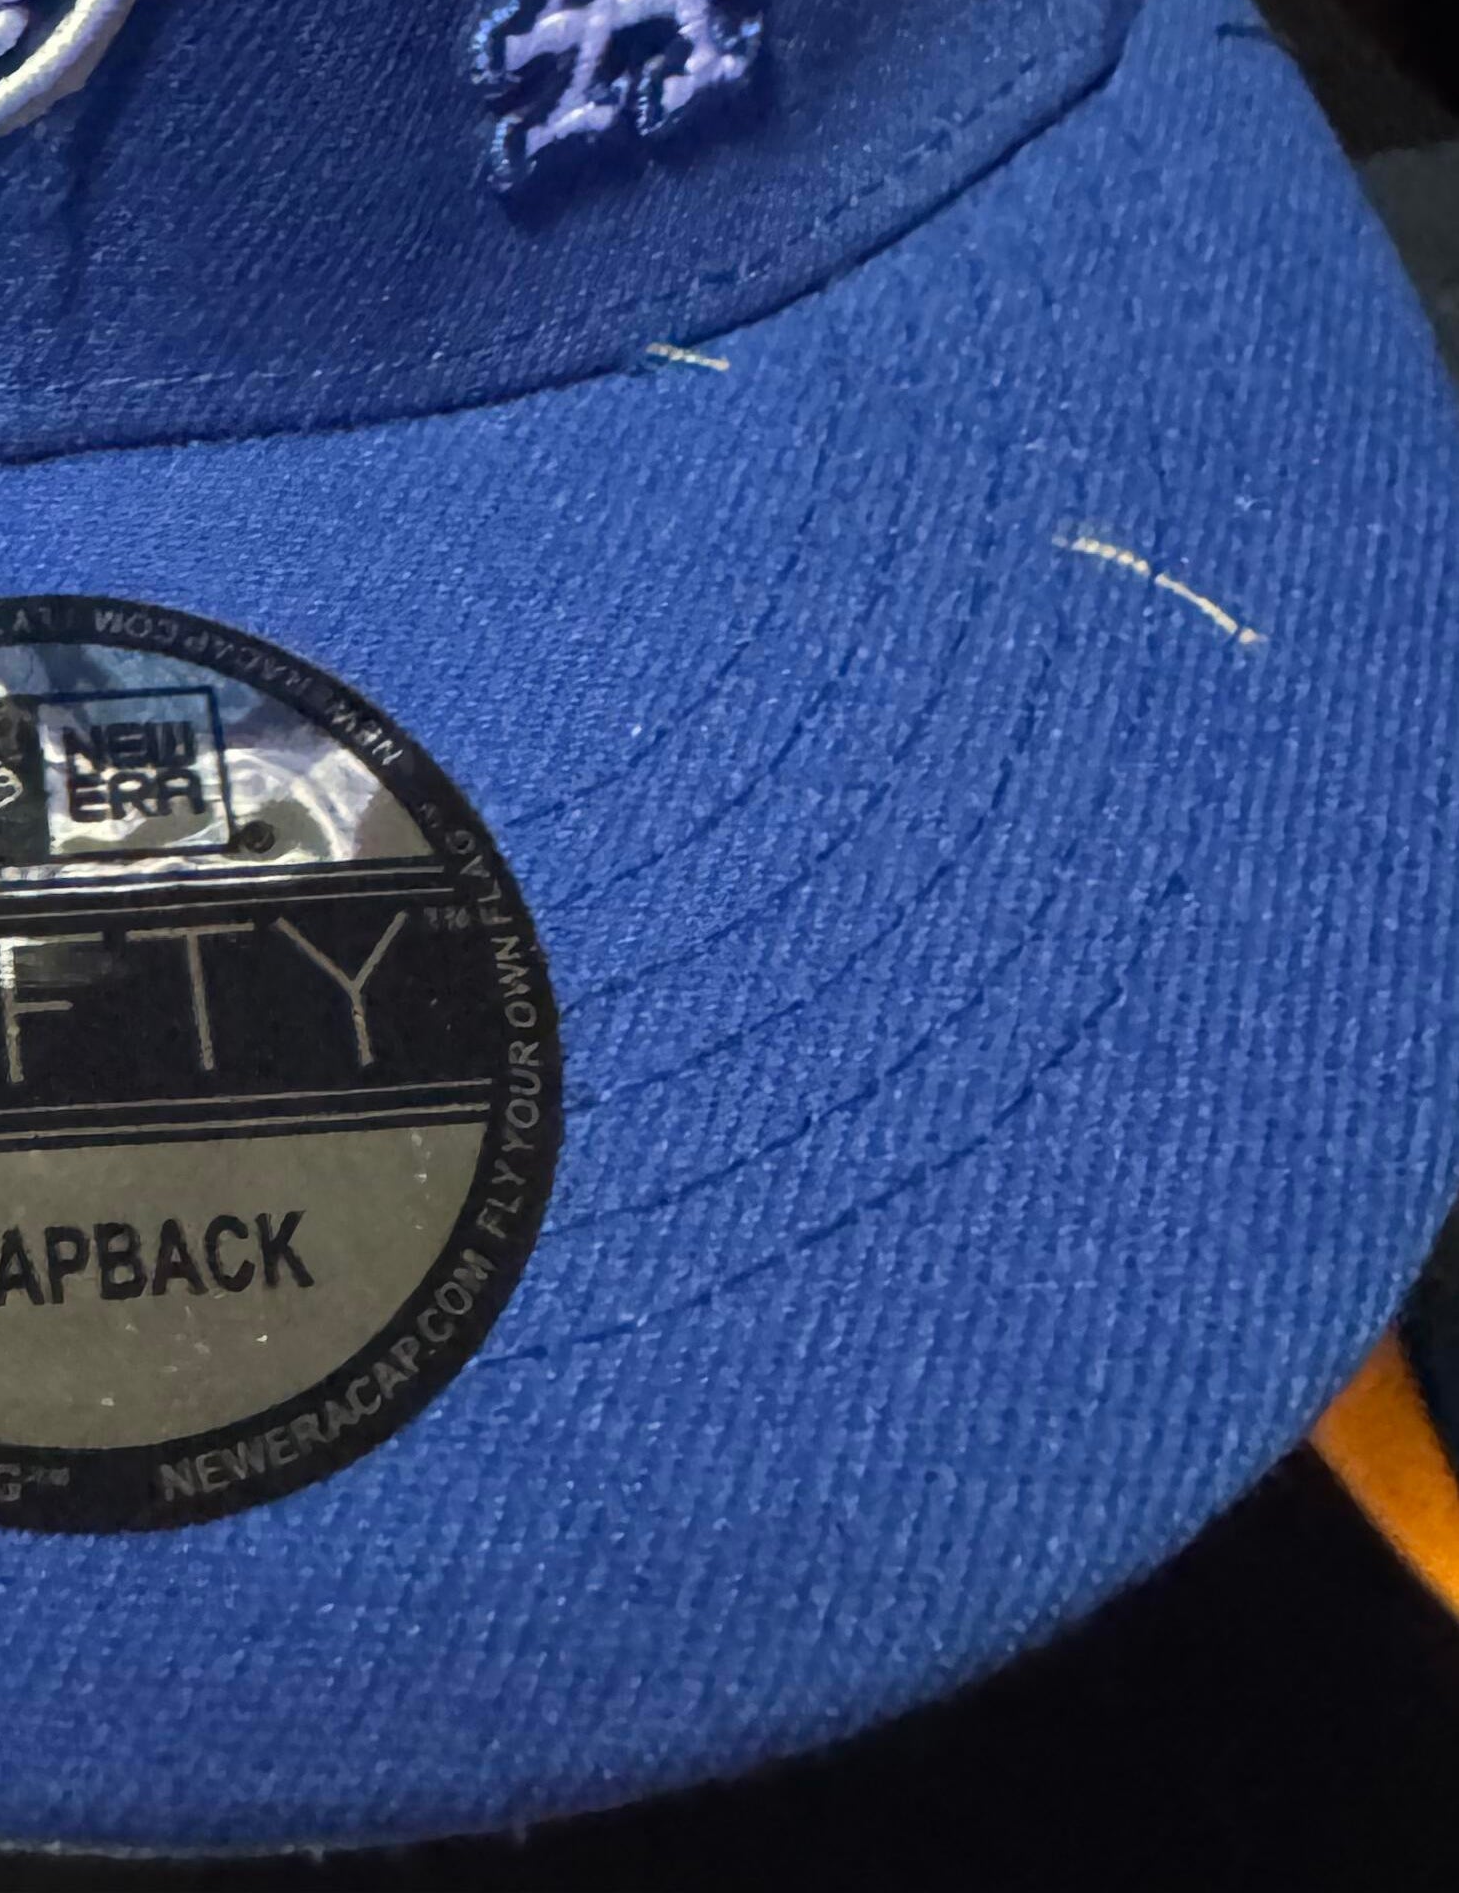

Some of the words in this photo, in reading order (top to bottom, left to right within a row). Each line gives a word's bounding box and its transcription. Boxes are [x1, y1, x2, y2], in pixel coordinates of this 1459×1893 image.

[62, 720, 198, 770] NEW
[69, 768, 208, 823] ERA
[490, 934, 539, 1030] OWN
[500, 1040, 545, 1155] YOUR
[476, 1158, 527, 1240] FLY
[157, 1247, 499, 1503] NEWERACAP.COM
